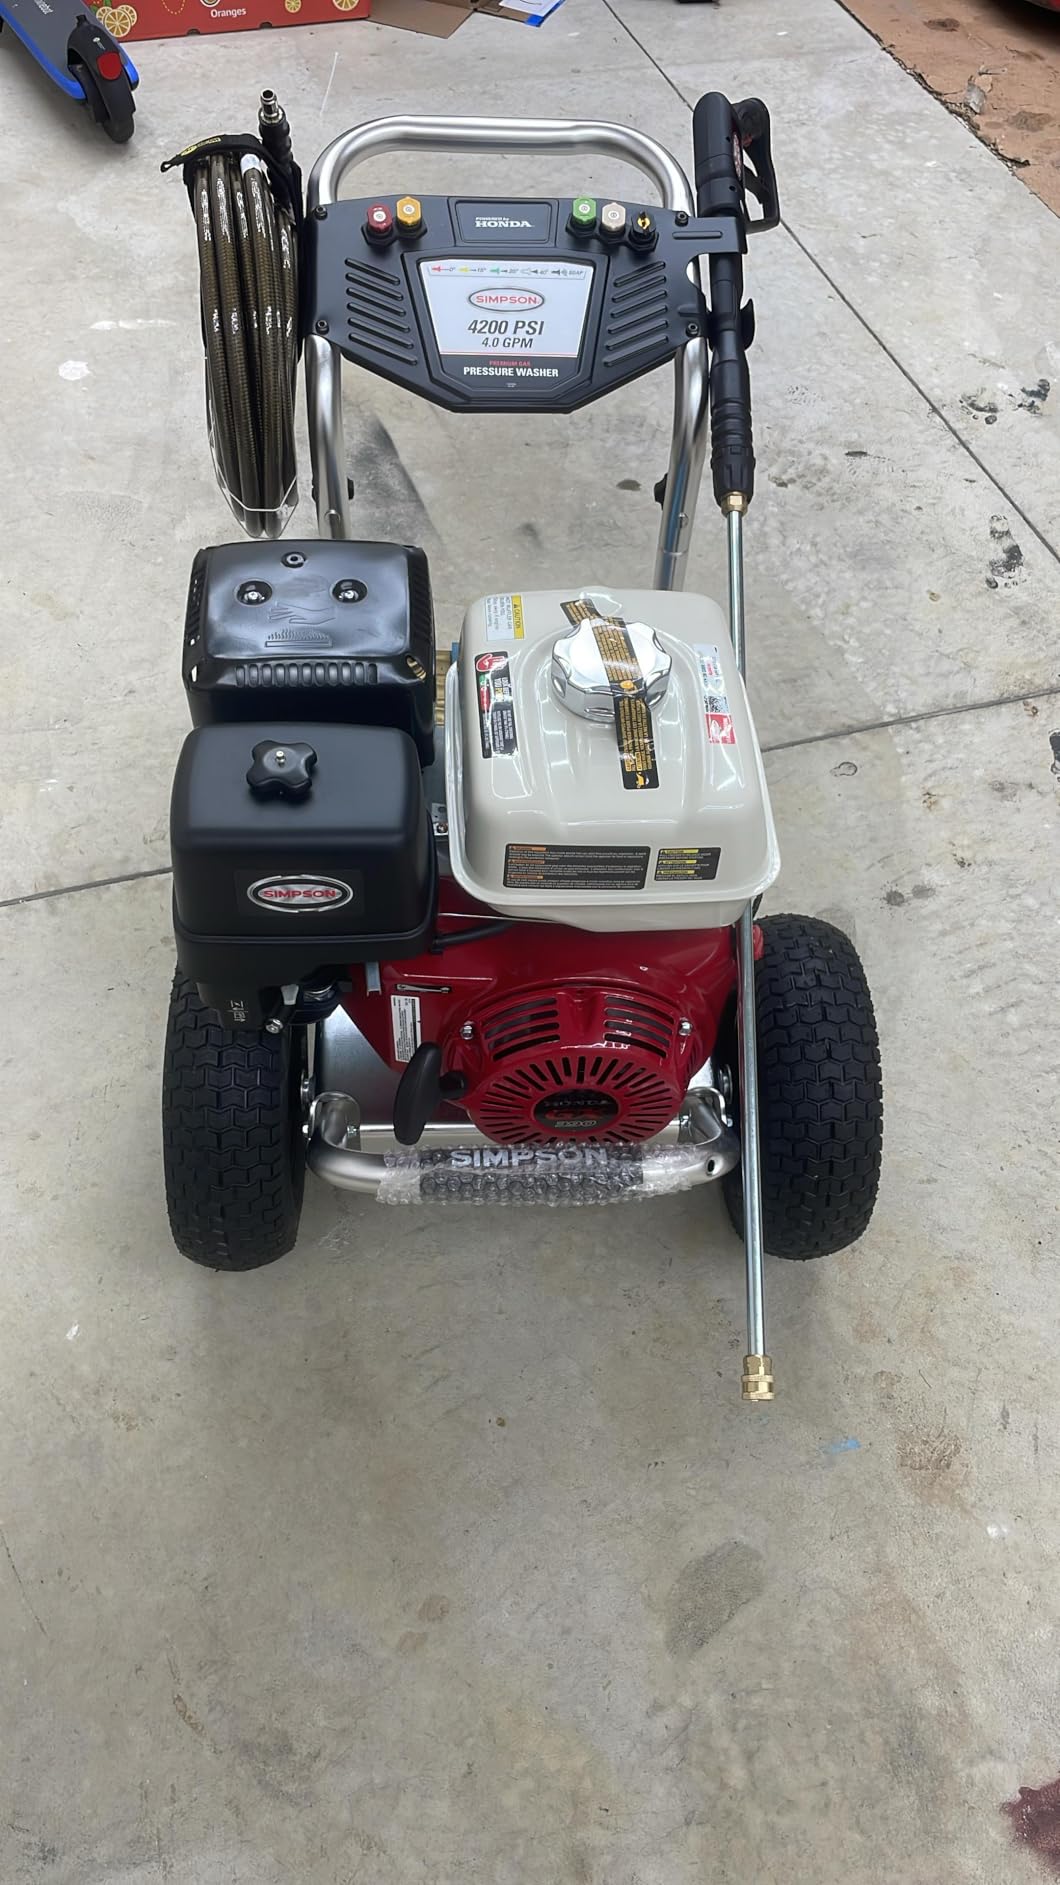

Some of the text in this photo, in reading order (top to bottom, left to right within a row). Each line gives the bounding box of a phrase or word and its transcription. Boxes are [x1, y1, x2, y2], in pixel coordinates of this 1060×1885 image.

[210, 8, 247, 18] Oranges
[475, 220, 532, 228] HONDA
[475, 295, 538, 304] SIMPSON
[468, 319, 545, 335] 4200 PSI
[481, 337, 534, 349] 4.0 GPM
[463, 367, 559, 378] PRESSURE WASHER
[263, 889, 337, 899] SIMPSON
[450, 1147, 609, 1169] SIMPSON
